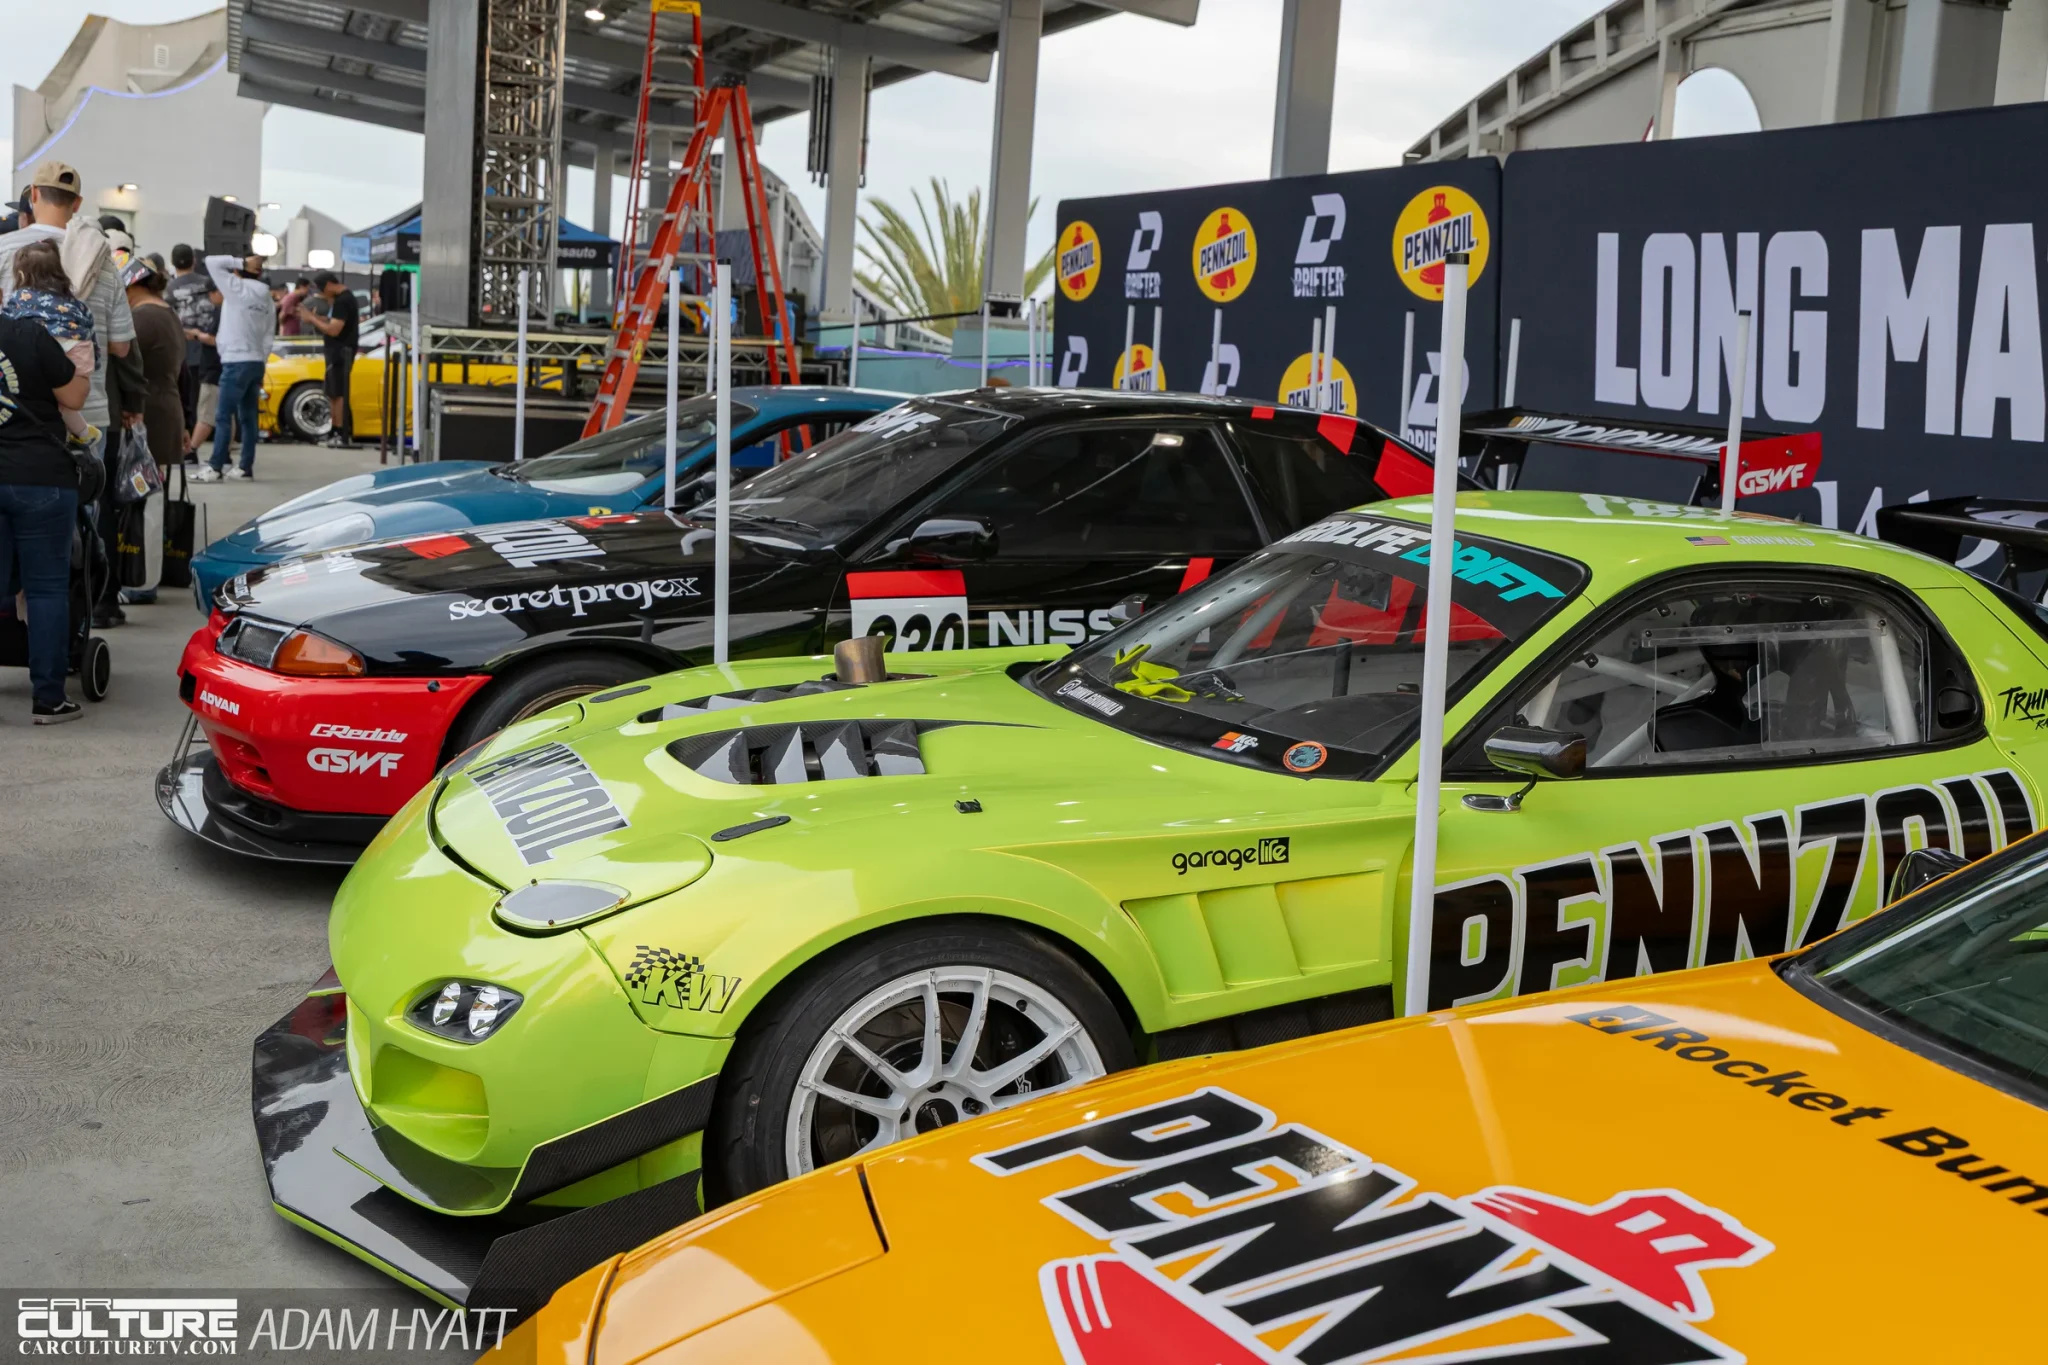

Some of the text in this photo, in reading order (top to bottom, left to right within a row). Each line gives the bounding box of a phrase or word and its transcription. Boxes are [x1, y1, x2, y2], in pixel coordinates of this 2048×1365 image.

[1061, 240, 1096, 279] PENNZOIL
[1199, 226, 1250, 280] PENNZOIL
[1403, 212, 1478, 273] PENNZOIL
[1125, 272, 1160, 298] DRIFTER
[1291, 266, 1346, 298] DRIFTER
[1595, 231, 1829, 424] LONG
[1738, 463, 1807, 495] GSWF
[1731, 535, 1816, 547] GRUNWALD
[449, 577, 701, 621] secretprojex
[199, 690, 240, 716] ADVAN
[310, 723, 408, 743] GReddy
[306, 747, 404, 778] GSWF
[464, 741, 632, 867] PENNZOIL
[641, 966, 742, 1014] KW
[1631, 1027, 1894, 1127] Rocket
